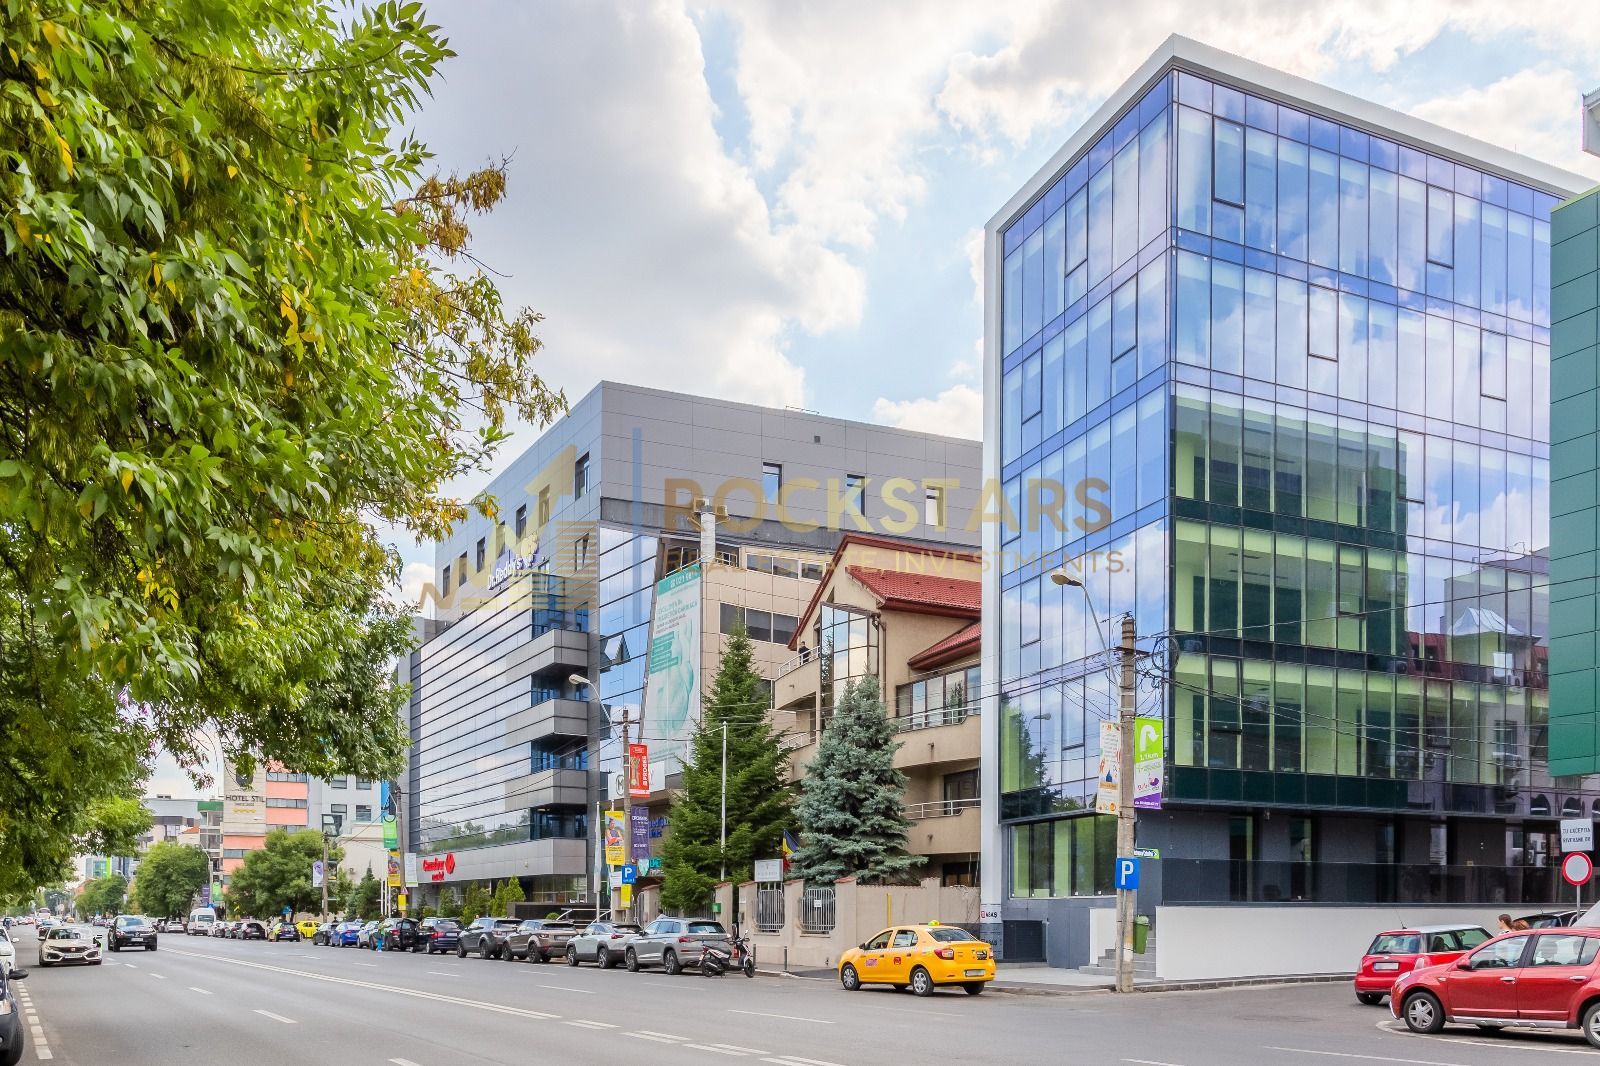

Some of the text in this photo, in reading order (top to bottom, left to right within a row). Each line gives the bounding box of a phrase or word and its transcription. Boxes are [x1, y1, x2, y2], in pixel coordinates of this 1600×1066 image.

[225, 794, 249, 802] HOTEL
[624, 867, 633, 878] P
[1121, 860, 1134, 886] P
